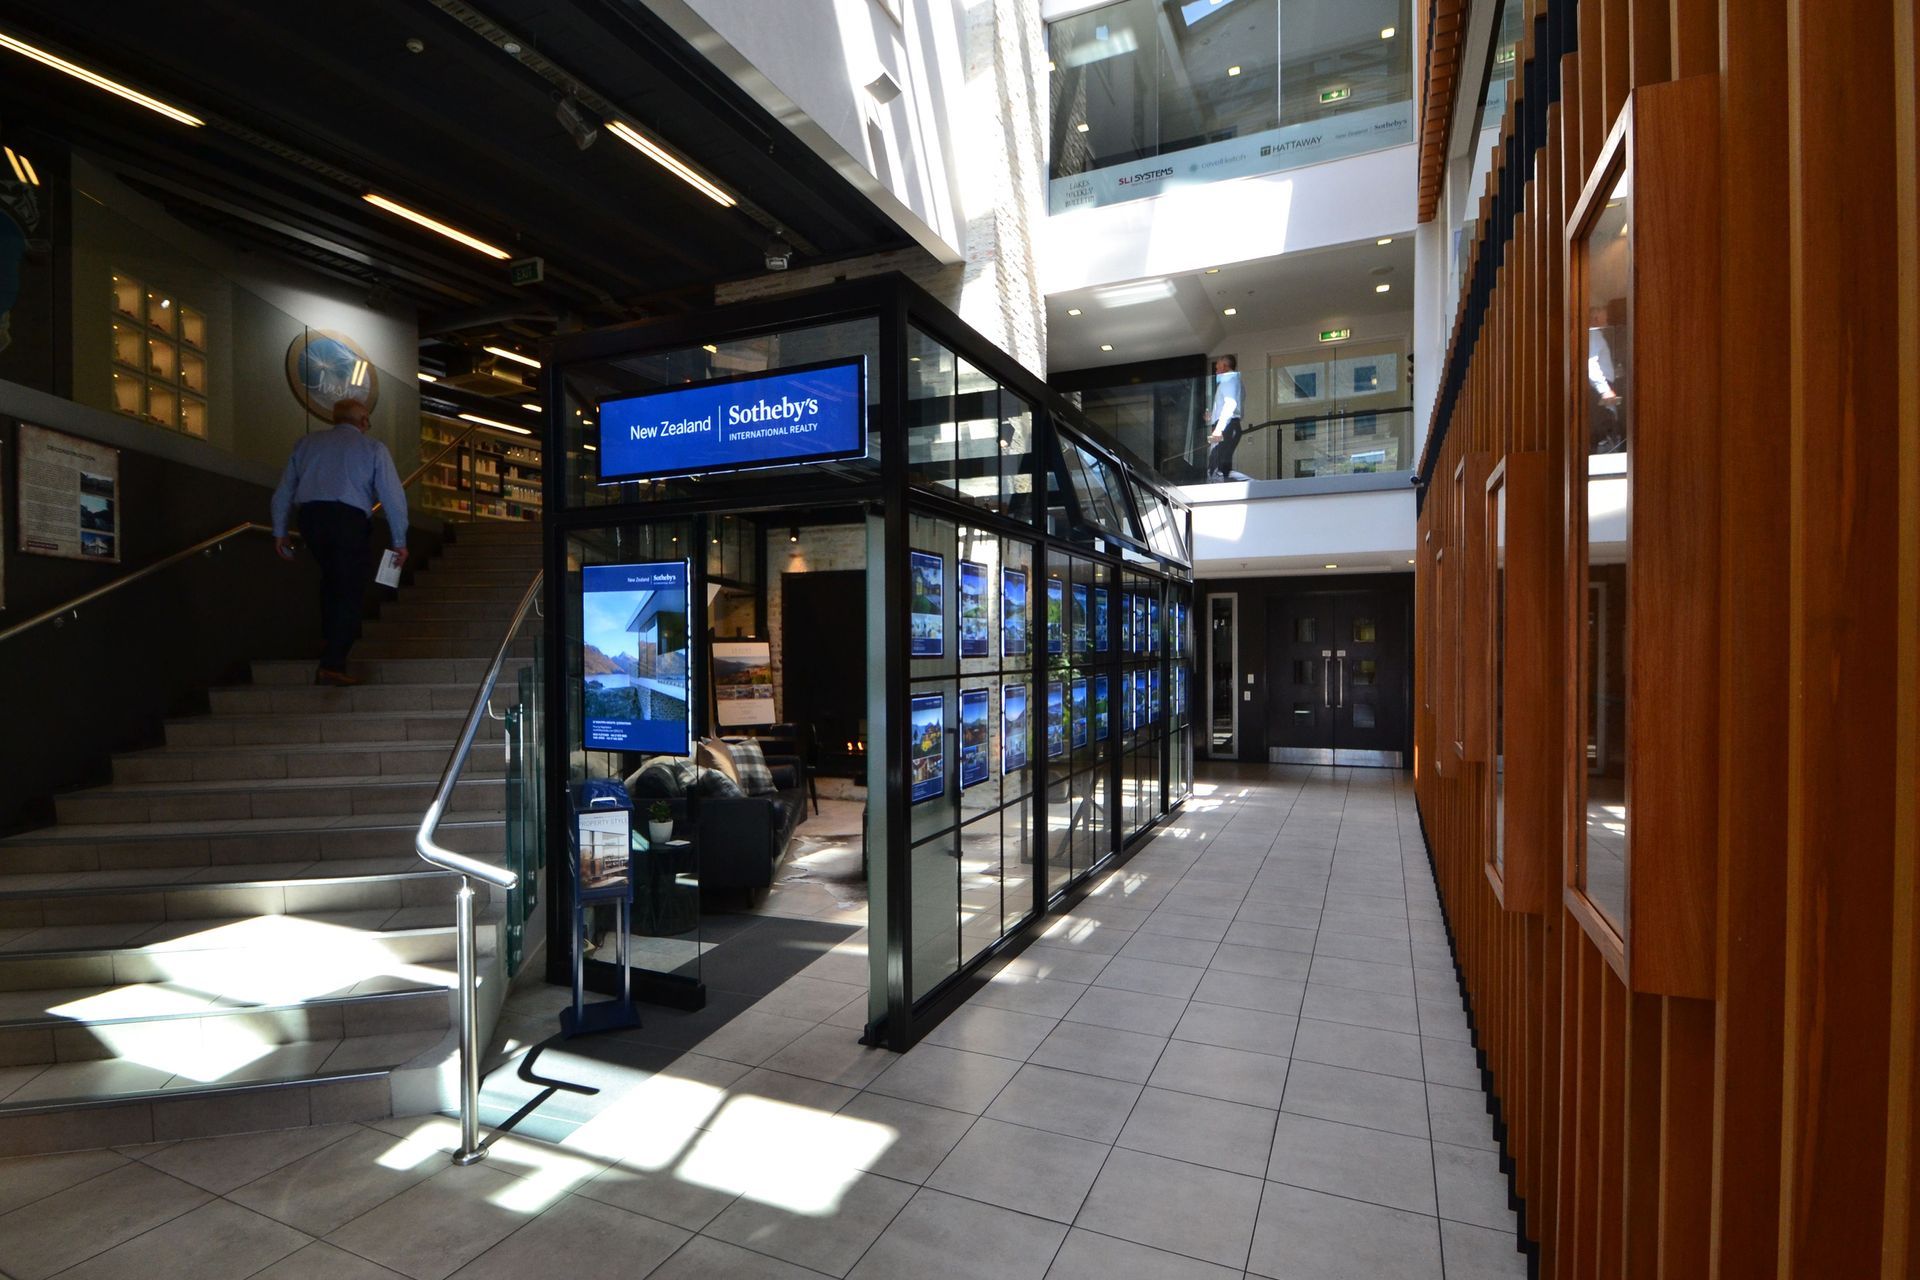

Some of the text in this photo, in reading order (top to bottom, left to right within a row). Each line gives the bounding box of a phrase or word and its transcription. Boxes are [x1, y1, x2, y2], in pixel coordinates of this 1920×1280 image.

[1272, 136, 1322, 153] HATTAWAY
[1118, 176, 1133, 186] SLI
[1134, 166, 1174, 182] SYSTEMS
[1069, 180, 1090, 191] LAKES
[516, 266, 532, 280] EXIT
[318, 370, 353, 398] hush
[630, 396, 819, 441] New Zealand Sotheby's
[729, 423, 818, 441] INTERNATIONAL REALTY
